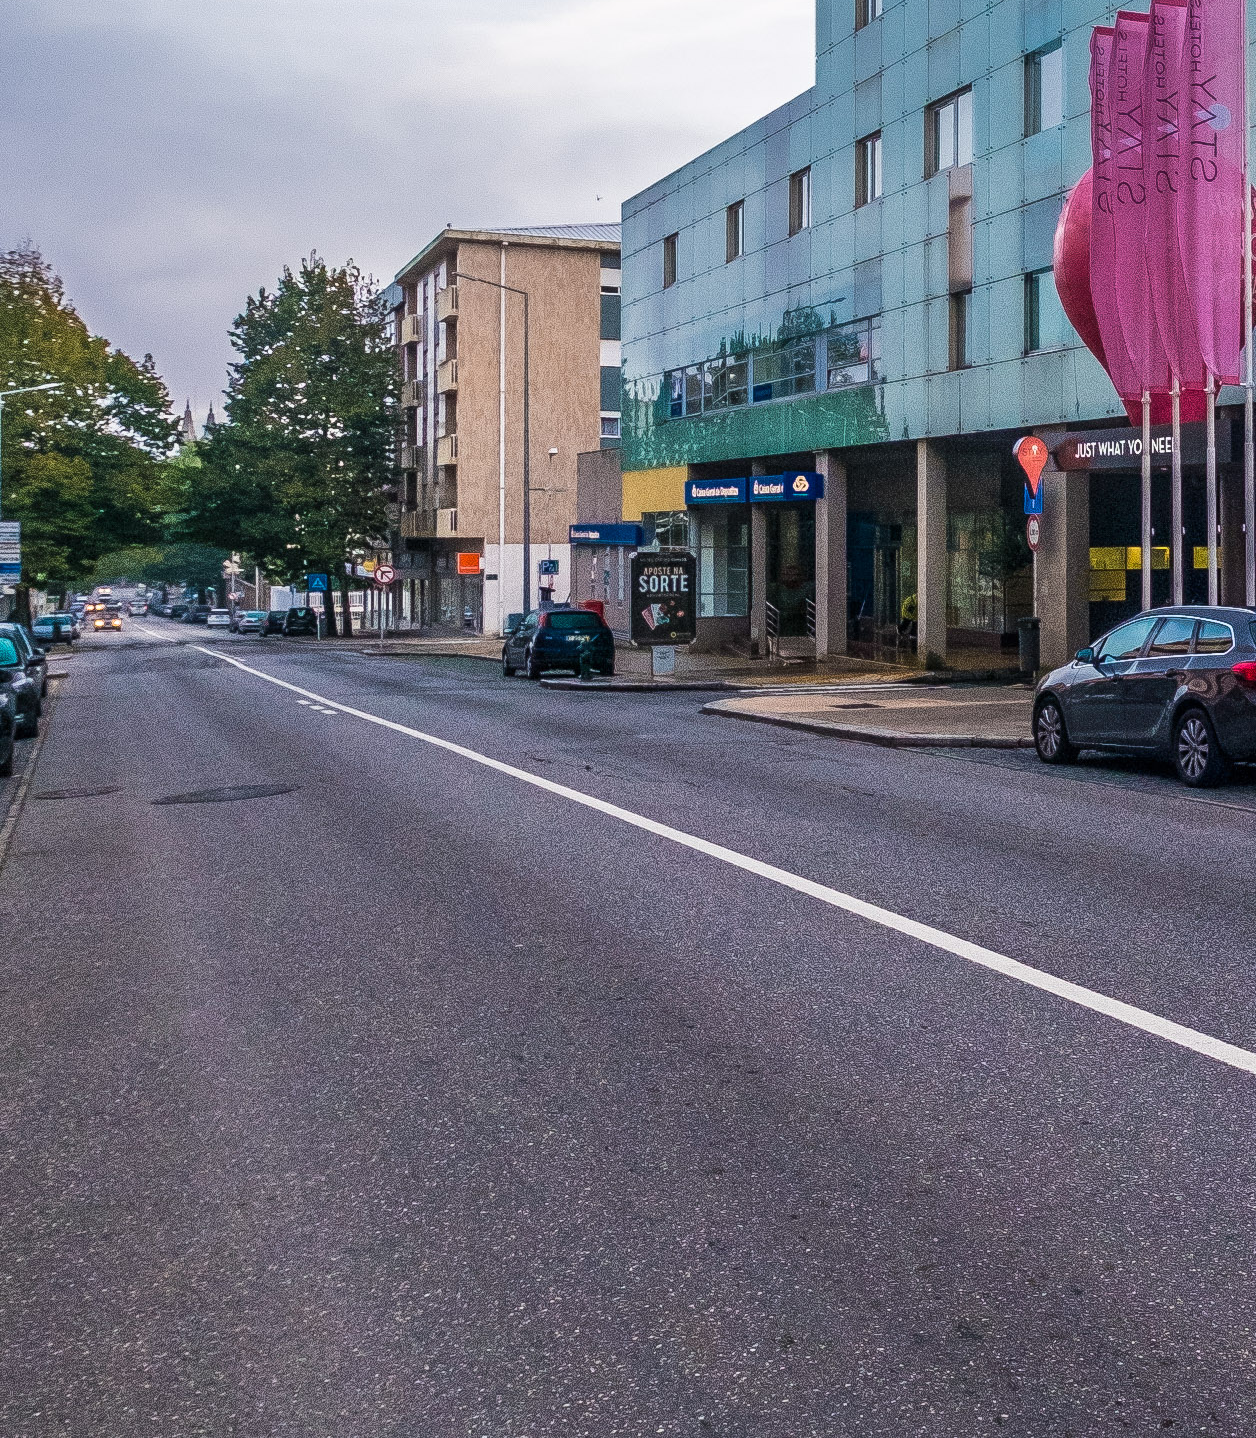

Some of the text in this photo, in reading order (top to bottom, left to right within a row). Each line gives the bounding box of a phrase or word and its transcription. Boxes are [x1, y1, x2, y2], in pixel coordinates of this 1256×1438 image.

[1075, 436, 1174, 458] JUST WHAT YO NEE
[643, 567, 684, 575] APOSTE NA
[639, 575, 689, 593] SORTE
